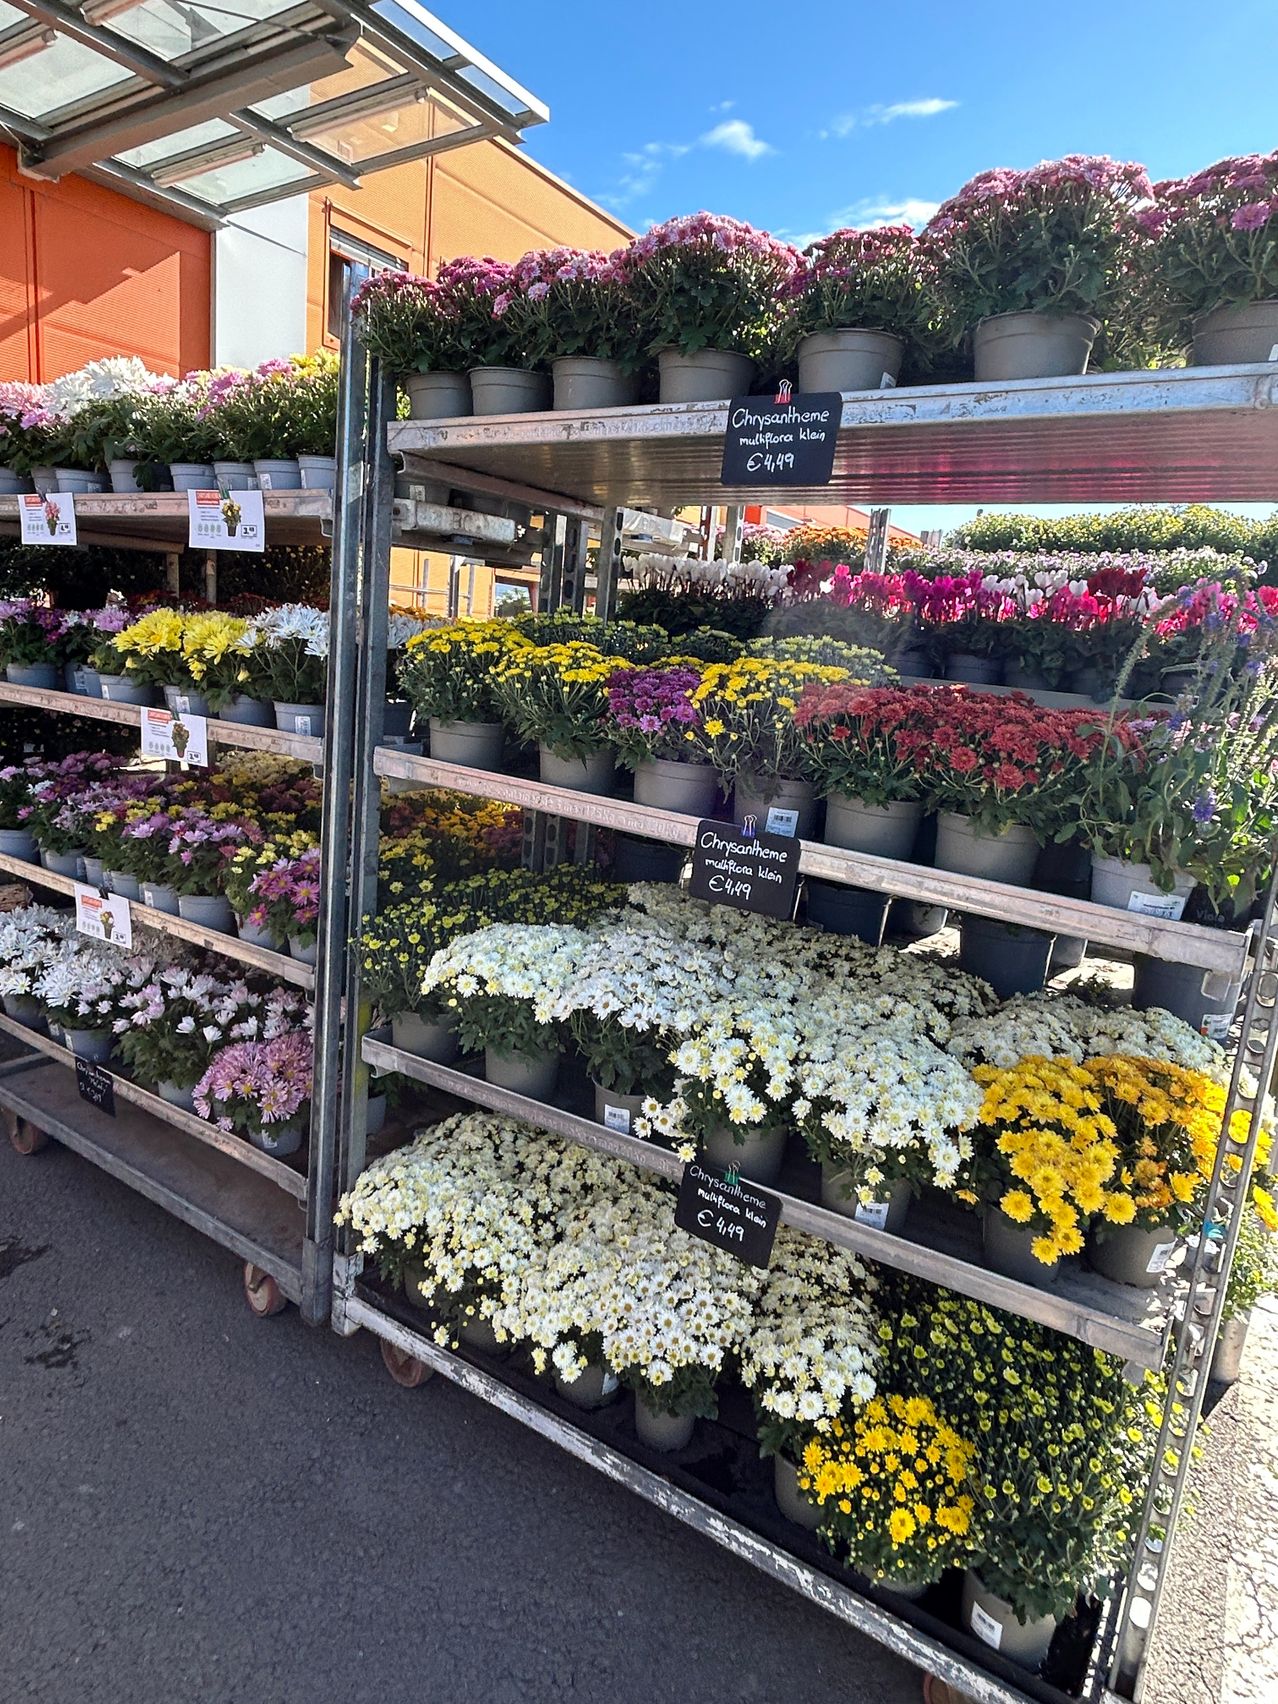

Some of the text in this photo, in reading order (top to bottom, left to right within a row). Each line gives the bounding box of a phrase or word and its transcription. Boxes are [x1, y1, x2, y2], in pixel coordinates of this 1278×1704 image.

[732, 405, 830, 431] Chrysantheme
[739, 427, 826, 450] multiflora klein
[700, 831, 788, 863] Chrysantheme
[705, 858, 782, 884] multiflora klein
[689, 1165, 767, 1210] Chrysantheme
[697, 1188, 767, 1229] multiflora klein
